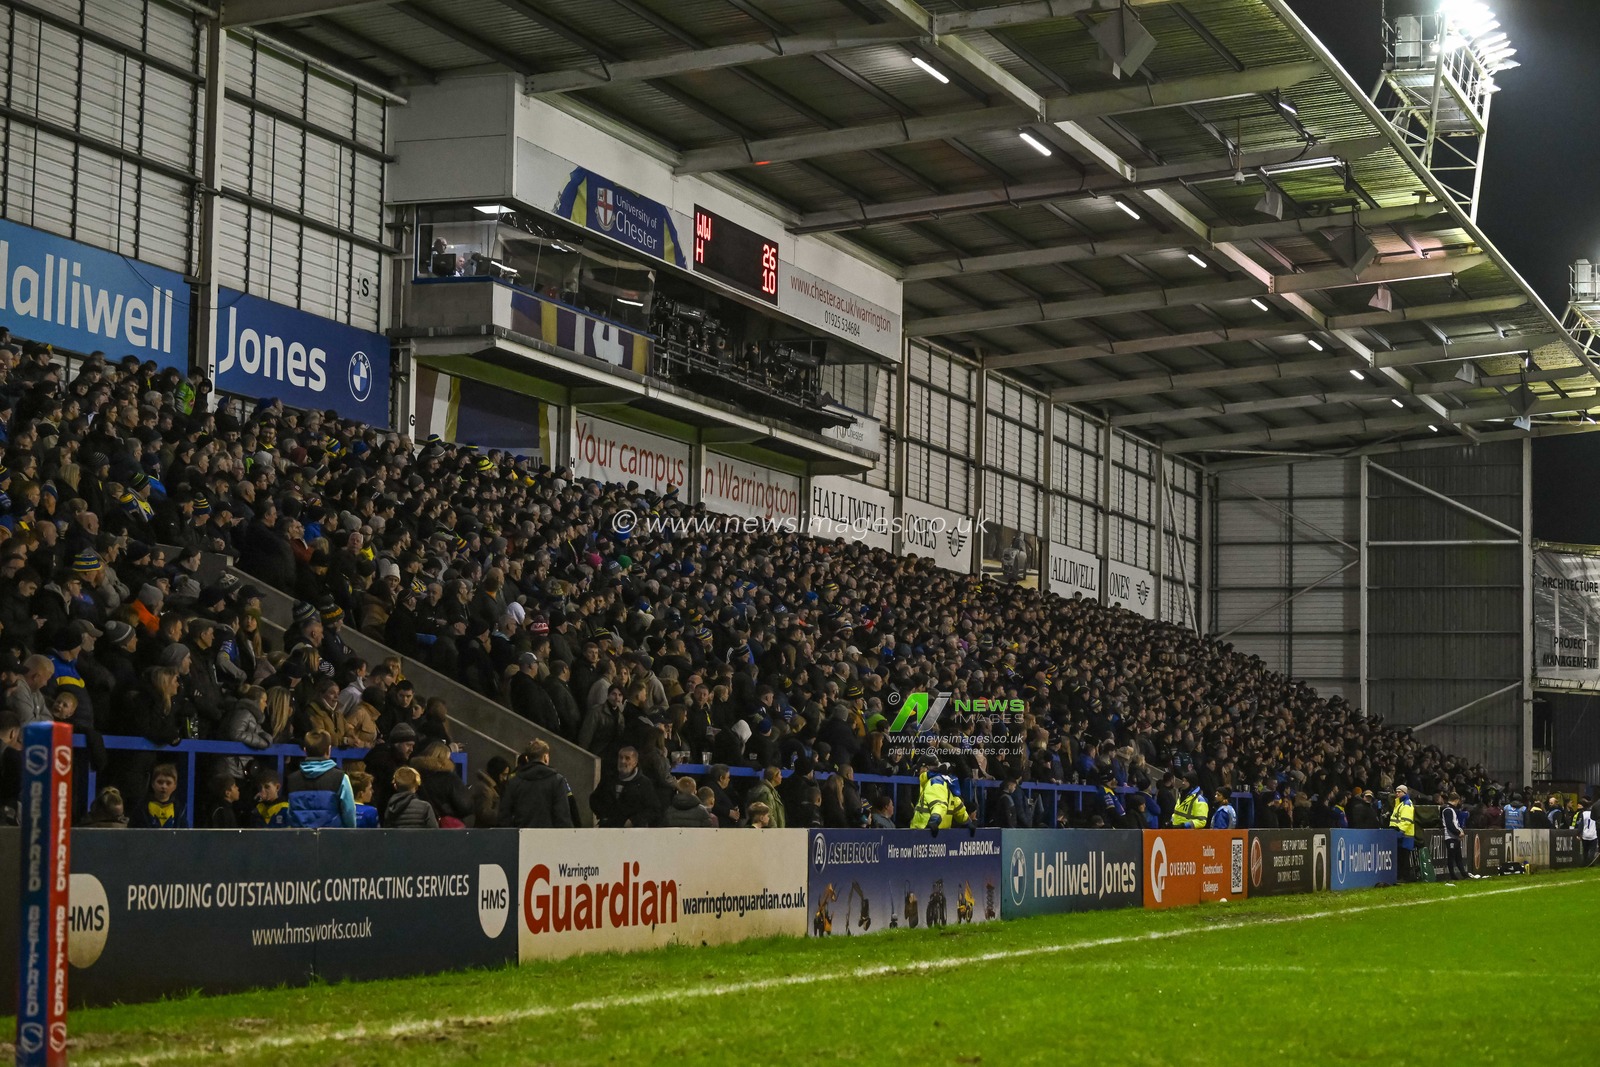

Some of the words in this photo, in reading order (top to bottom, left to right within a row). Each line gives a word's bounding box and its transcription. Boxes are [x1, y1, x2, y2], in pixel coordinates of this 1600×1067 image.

[616, 195, 649, 228] University
[650, 216, 658, 230] of
[615, 210, 658, 250] Chester
[695, 237, 705, 264] H
[761, 243, 777, 271] 26
[361, 278, 370, 298] S
[762, 270, 777, 295] 10
[790, 275, 892, 333] www.chester.ac.uk/warrington
[824, 309, 841, 329] 01925
[218, 305, 327, 393] Jones
[208, 363, 216, 379] F
[409, 414, 416, 427] G
[575, 420, 616, 469] Your
[618, 443, 685, 492] campus
[704, 468, 714, 496] n
[716, 463, 799, 521] Warrington
[812, 485, 889, 537] HALLIWELL
[1050, 554, 1097, 592] ALLIWELL
[1109, 571, 1131, 601] ONES
[1541, 576, 1600, 594] ARCHITECTURE
[1553, 636, 1588, 651] PROJECT
[1542, 653, 1598, 669] MANAGEMENT
[29, 781, 43, 893] BETFRED
[55, 781, 68, 893] BETFRED
[827, 841, 880, 864] ASHBROOK
[887, 844, 900, 859] Hire
[900, 846, 913, 859] now
[558, 863, 600, 881] Warrington
[1169, 861, 1197, 877] OVERFORD
[1348, 843, 1375, 873] Halliwell
[1375, 843, 1393, 875] Jones
[1033, 850, 1097, 899] Halliwell
[1098, 850, 1137, 900] Jones
[127, 882, 212, 911] PROVIDING
[215, 878, 322, 908] OUTSTANDING
[324, 875, 414, 903] CONTRACTING
[415, 873, 470, 899] SERVICES
[480, 887, 507, 911] HMS
[523, 860, 678, 935] Guardian
[682, 886, 806, 919] warringtonguardian.co.uk
[251, 916, 373, 947] www.hmsworks.co.uk
[26, 904, 42, 1018] BETFRED
[53, 904, 67, 1017] BETFRED
